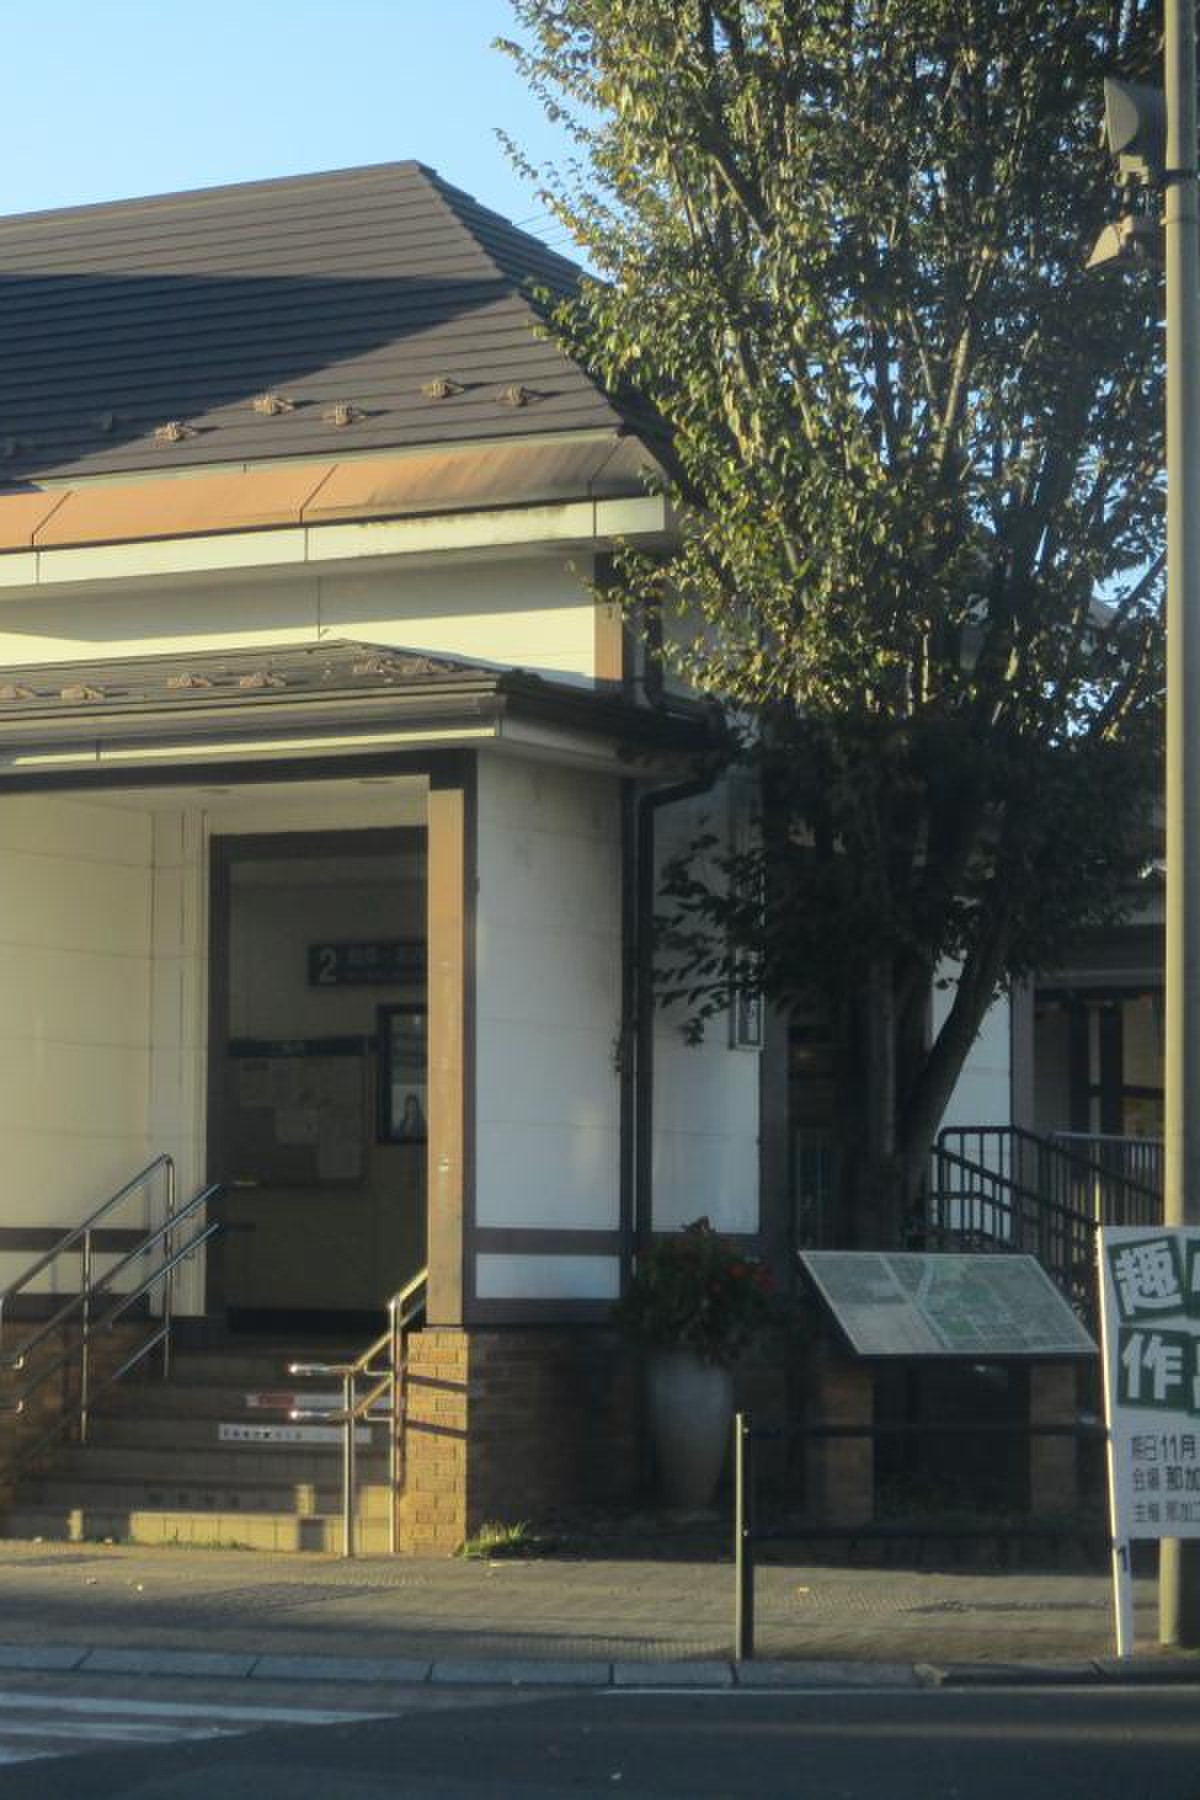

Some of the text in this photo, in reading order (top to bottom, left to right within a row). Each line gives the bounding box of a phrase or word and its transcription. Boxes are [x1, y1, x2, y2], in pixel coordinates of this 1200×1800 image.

[319, 948, 338, 983] 2
[1115, 1239, 1200, 1316] 趣
[1122, 1332, 1200, 1408] 作
